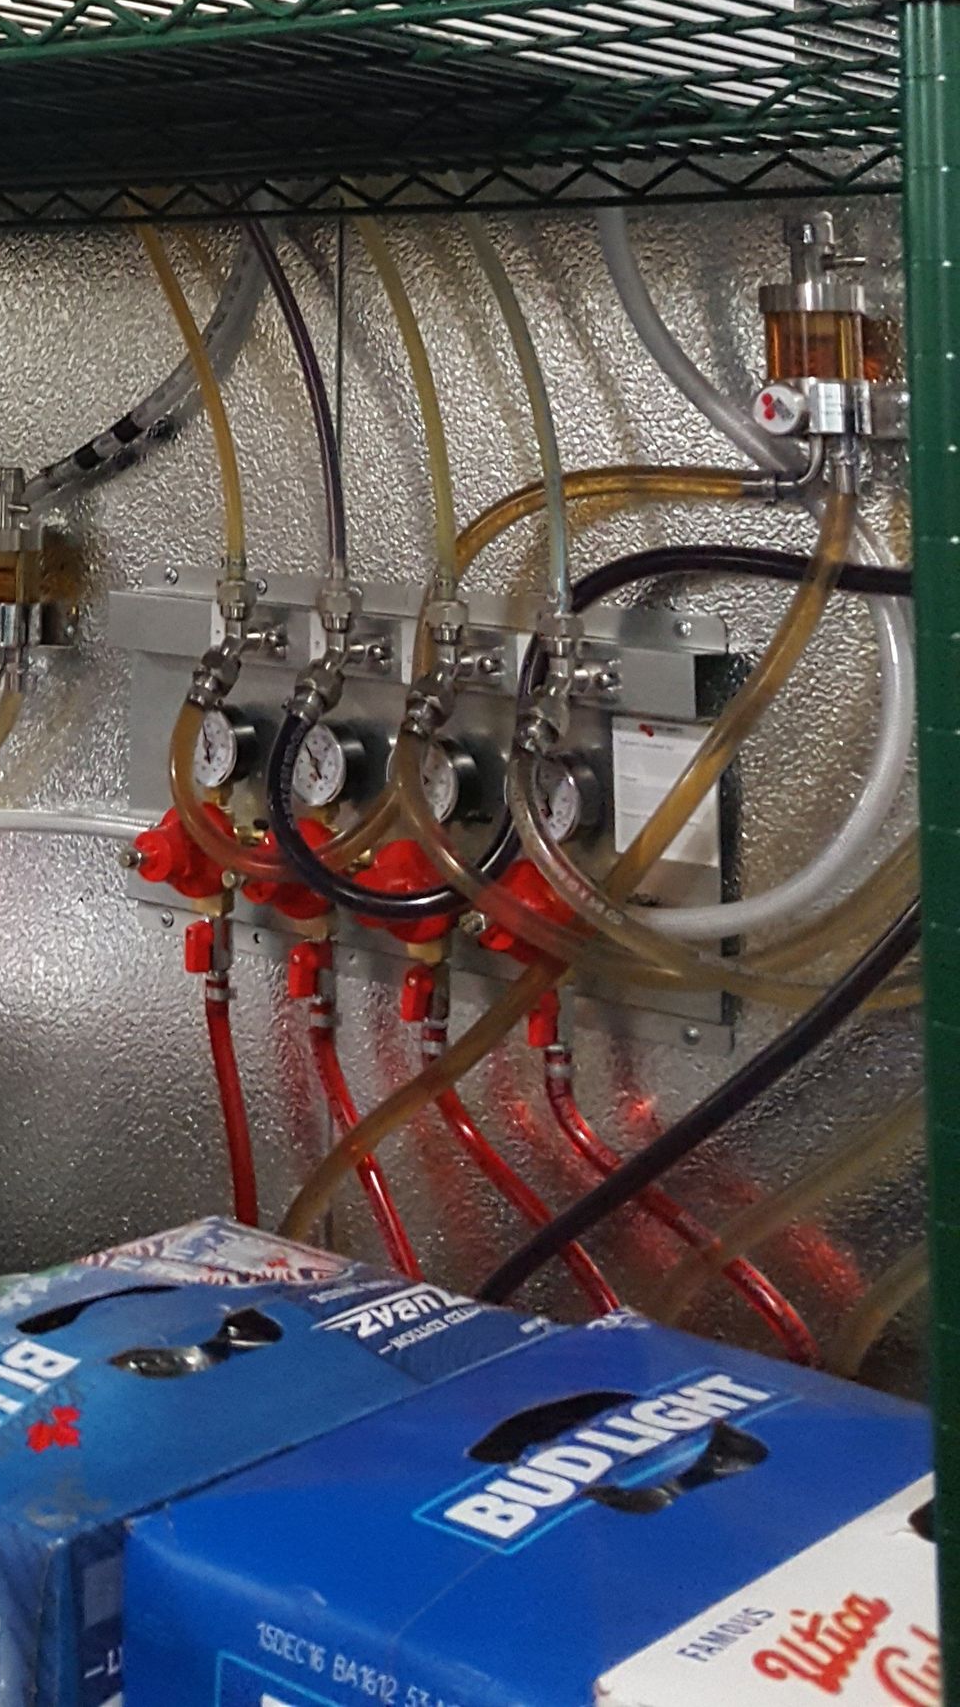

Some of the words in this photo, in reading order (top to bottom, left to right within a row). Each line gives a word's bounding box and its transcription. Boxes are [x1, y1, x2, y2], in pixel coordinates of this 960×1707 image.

[444, 1445, 614, 1540] BUD
[577, 1373, 773, 1455] LIGHT
[676, 1606, 776, 1663] FAMOUS
